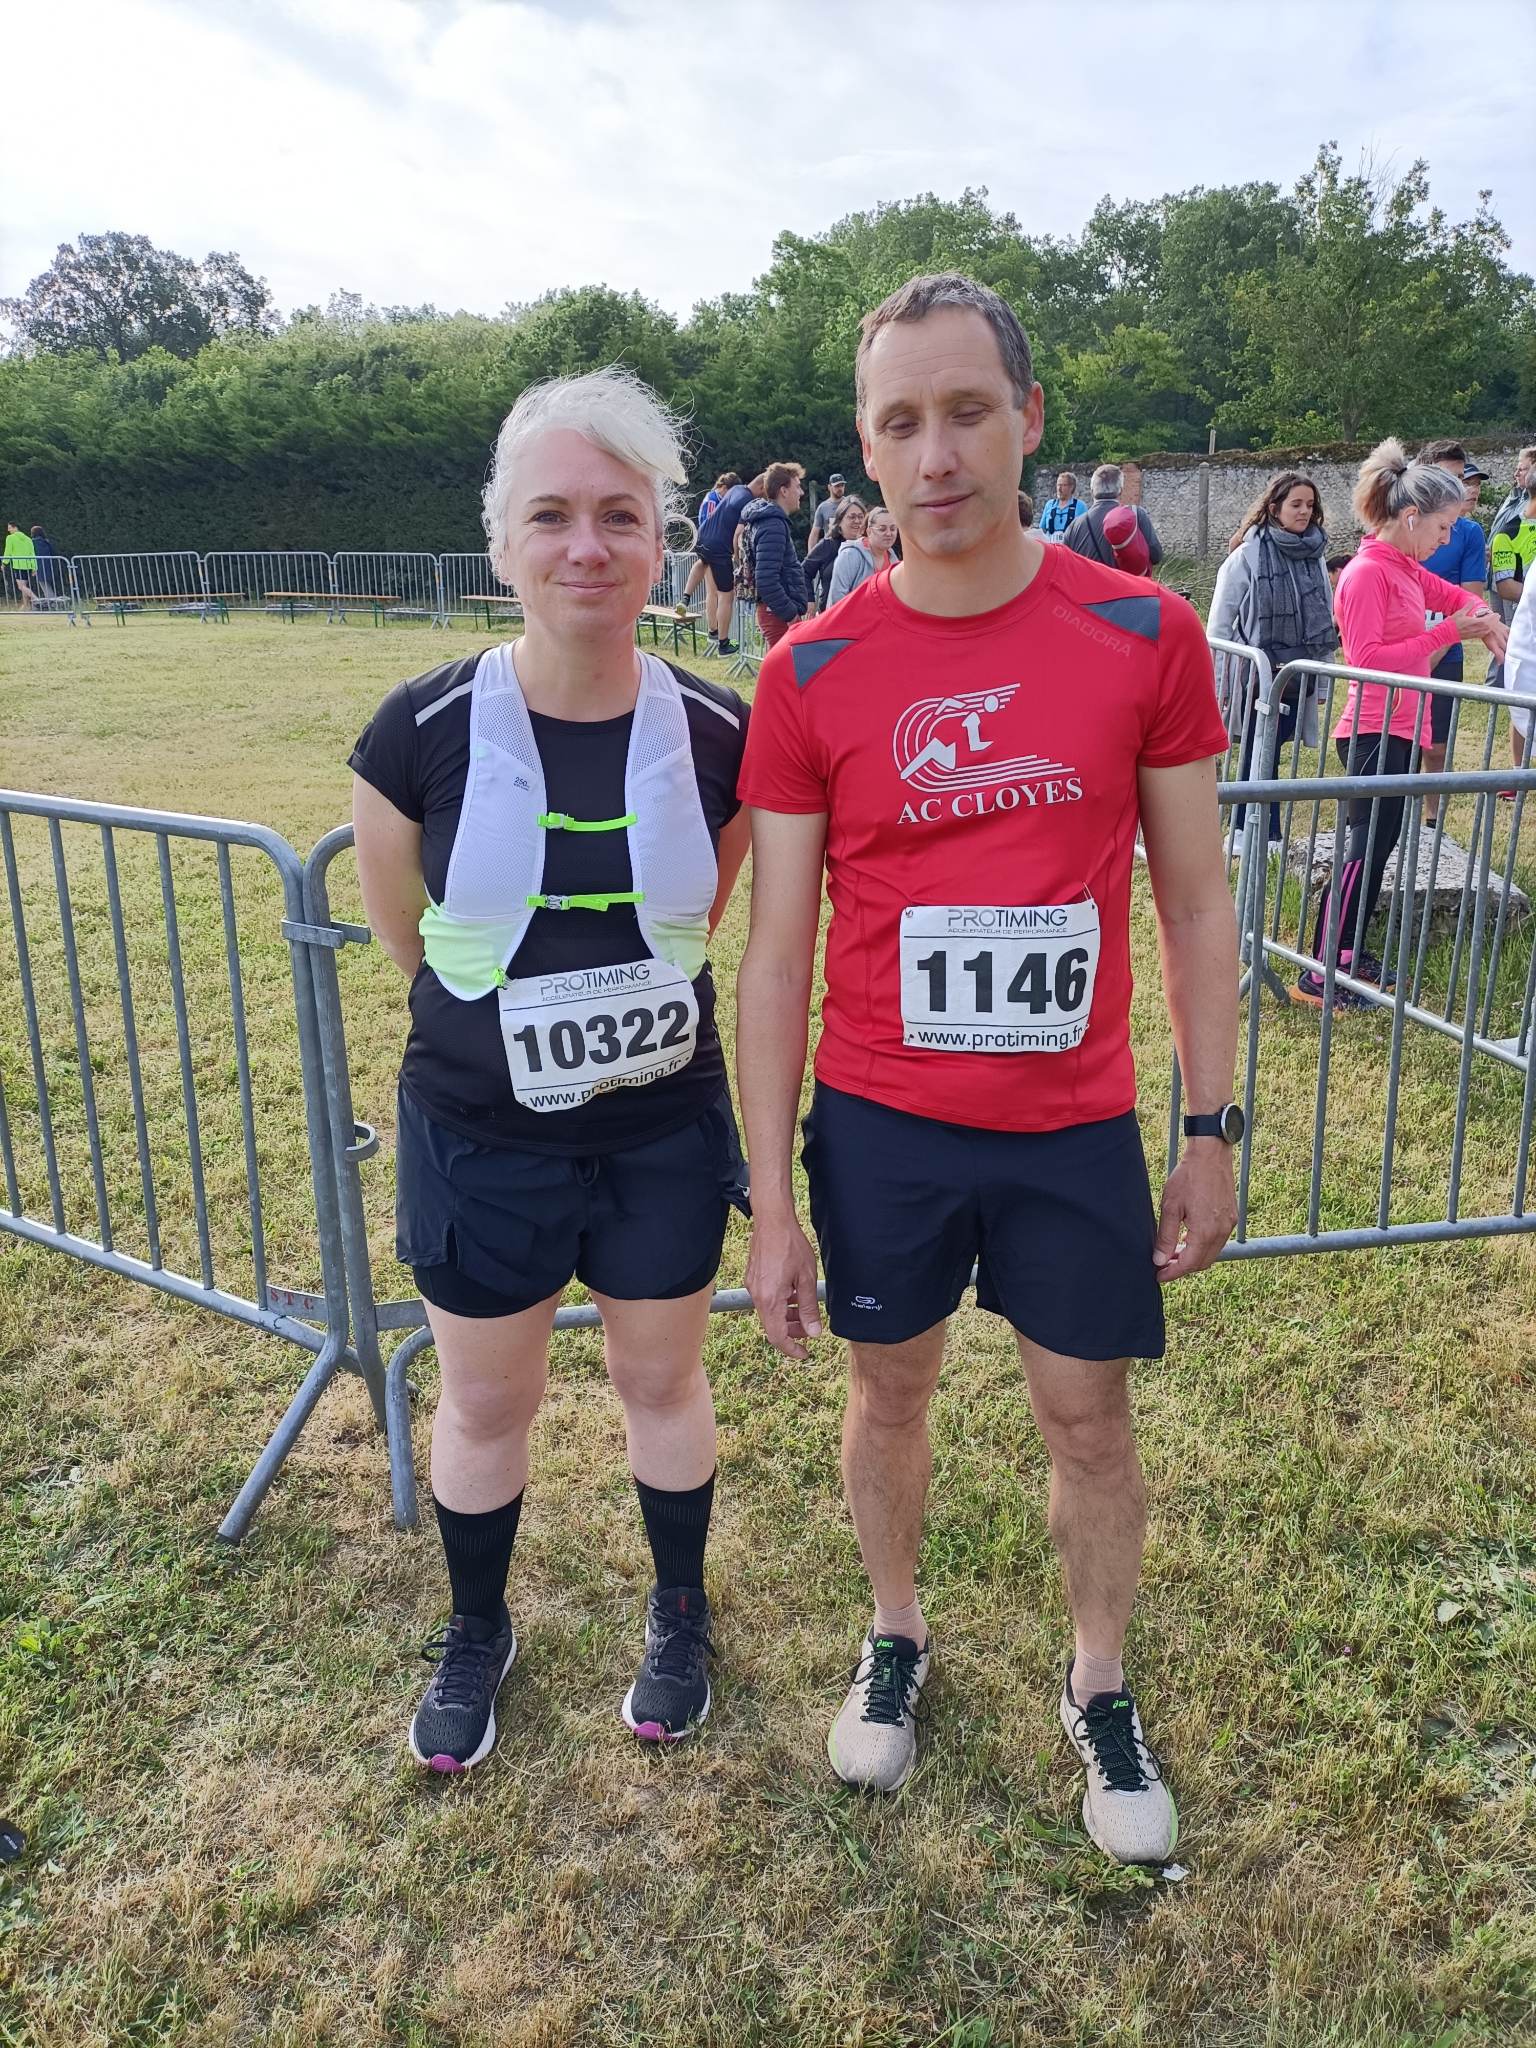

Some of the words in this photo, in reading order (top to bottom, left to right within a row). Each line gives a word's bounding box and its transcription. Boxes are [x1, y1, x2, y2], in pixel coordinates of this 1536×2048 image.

[1052, 604, 1132, 656] DIADORA
[897, 798, 942, 825] AC
[951, 777, 1083, 817] CLOYES
[947, 908, 1068, 928] PROTIMING
[539, 963, 650, 996] PROTIMING
[917, 947, 1088, 1014] 1146
[513, 1000, 689, 1072] 10322
[918, 1025, 1083, 1049] www.protiming.fr
